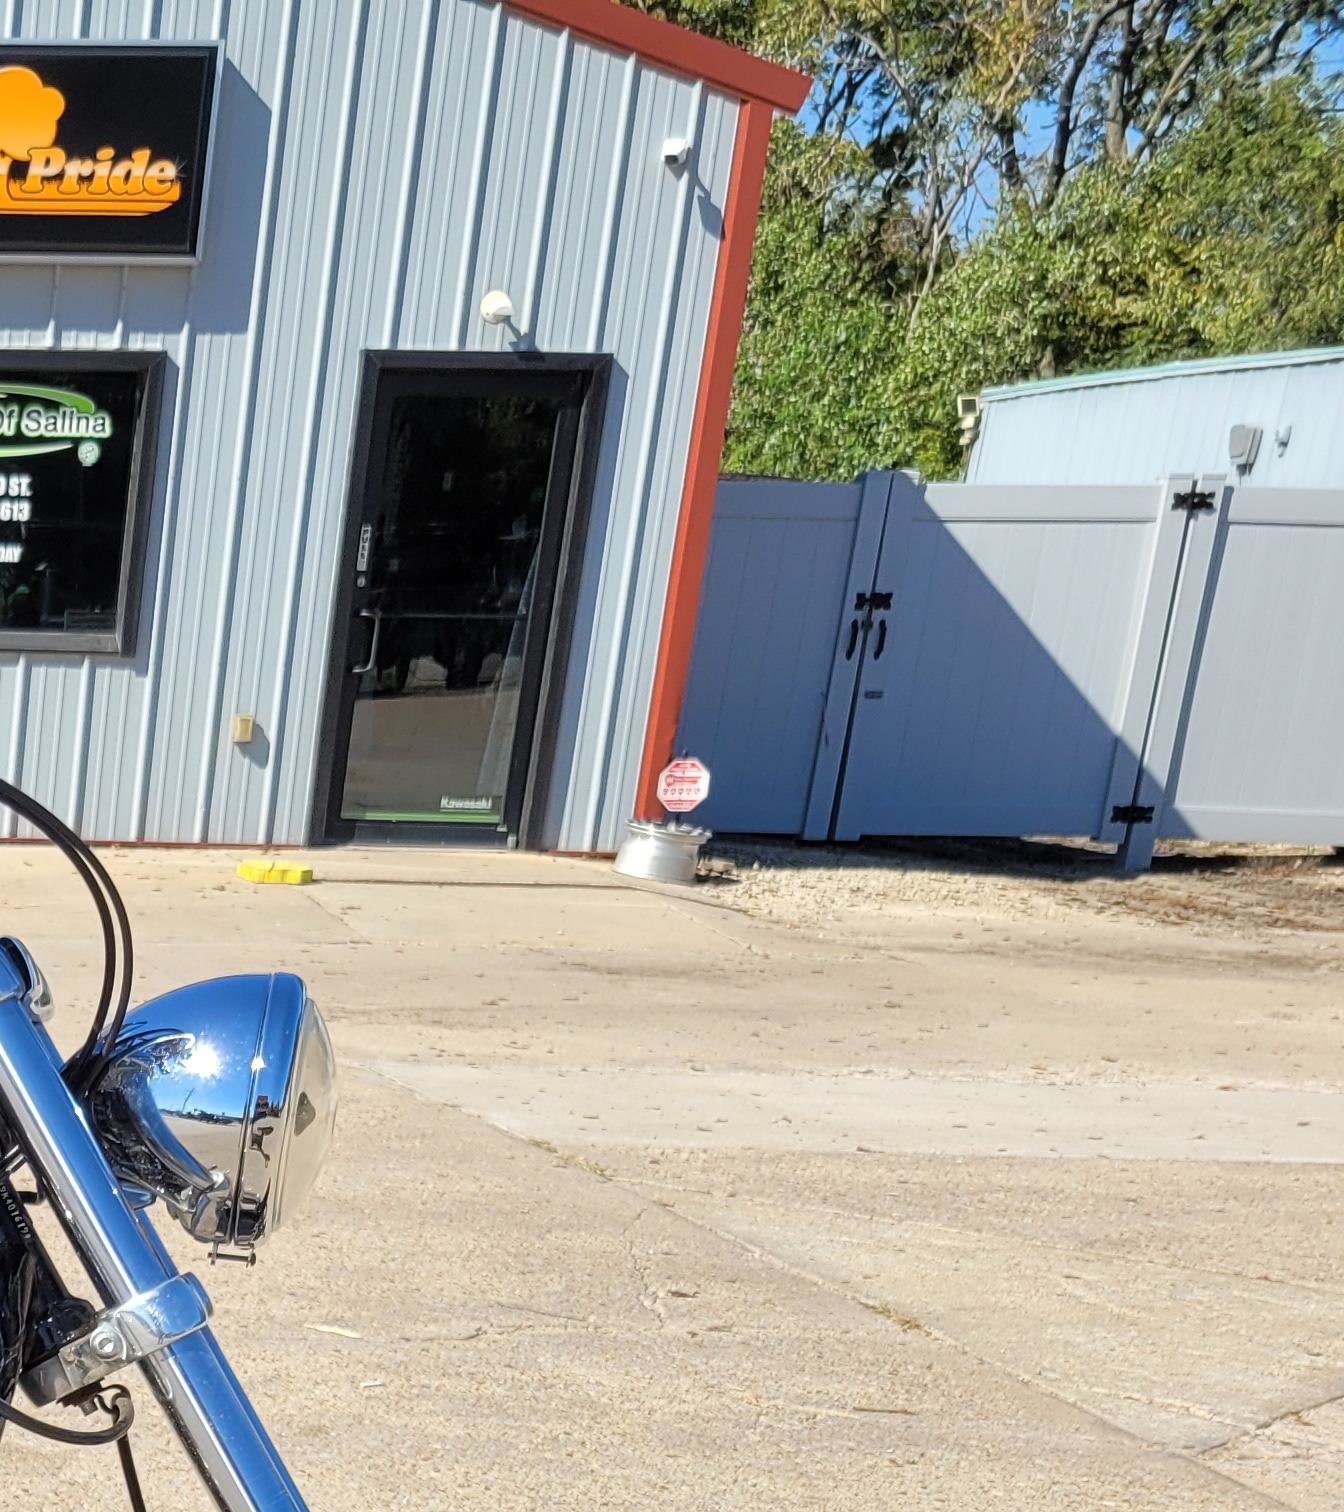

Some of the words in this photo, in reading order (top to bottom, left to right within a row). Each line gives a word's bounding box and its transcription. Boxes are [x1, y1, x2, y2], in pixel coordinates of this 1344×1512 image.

[21, 146, 177, 196] Pride
[23, 407, 110, 436] Salina
[8, 473, 33, 497] ST.
[440, 796, 492, 809] Kawasaki
